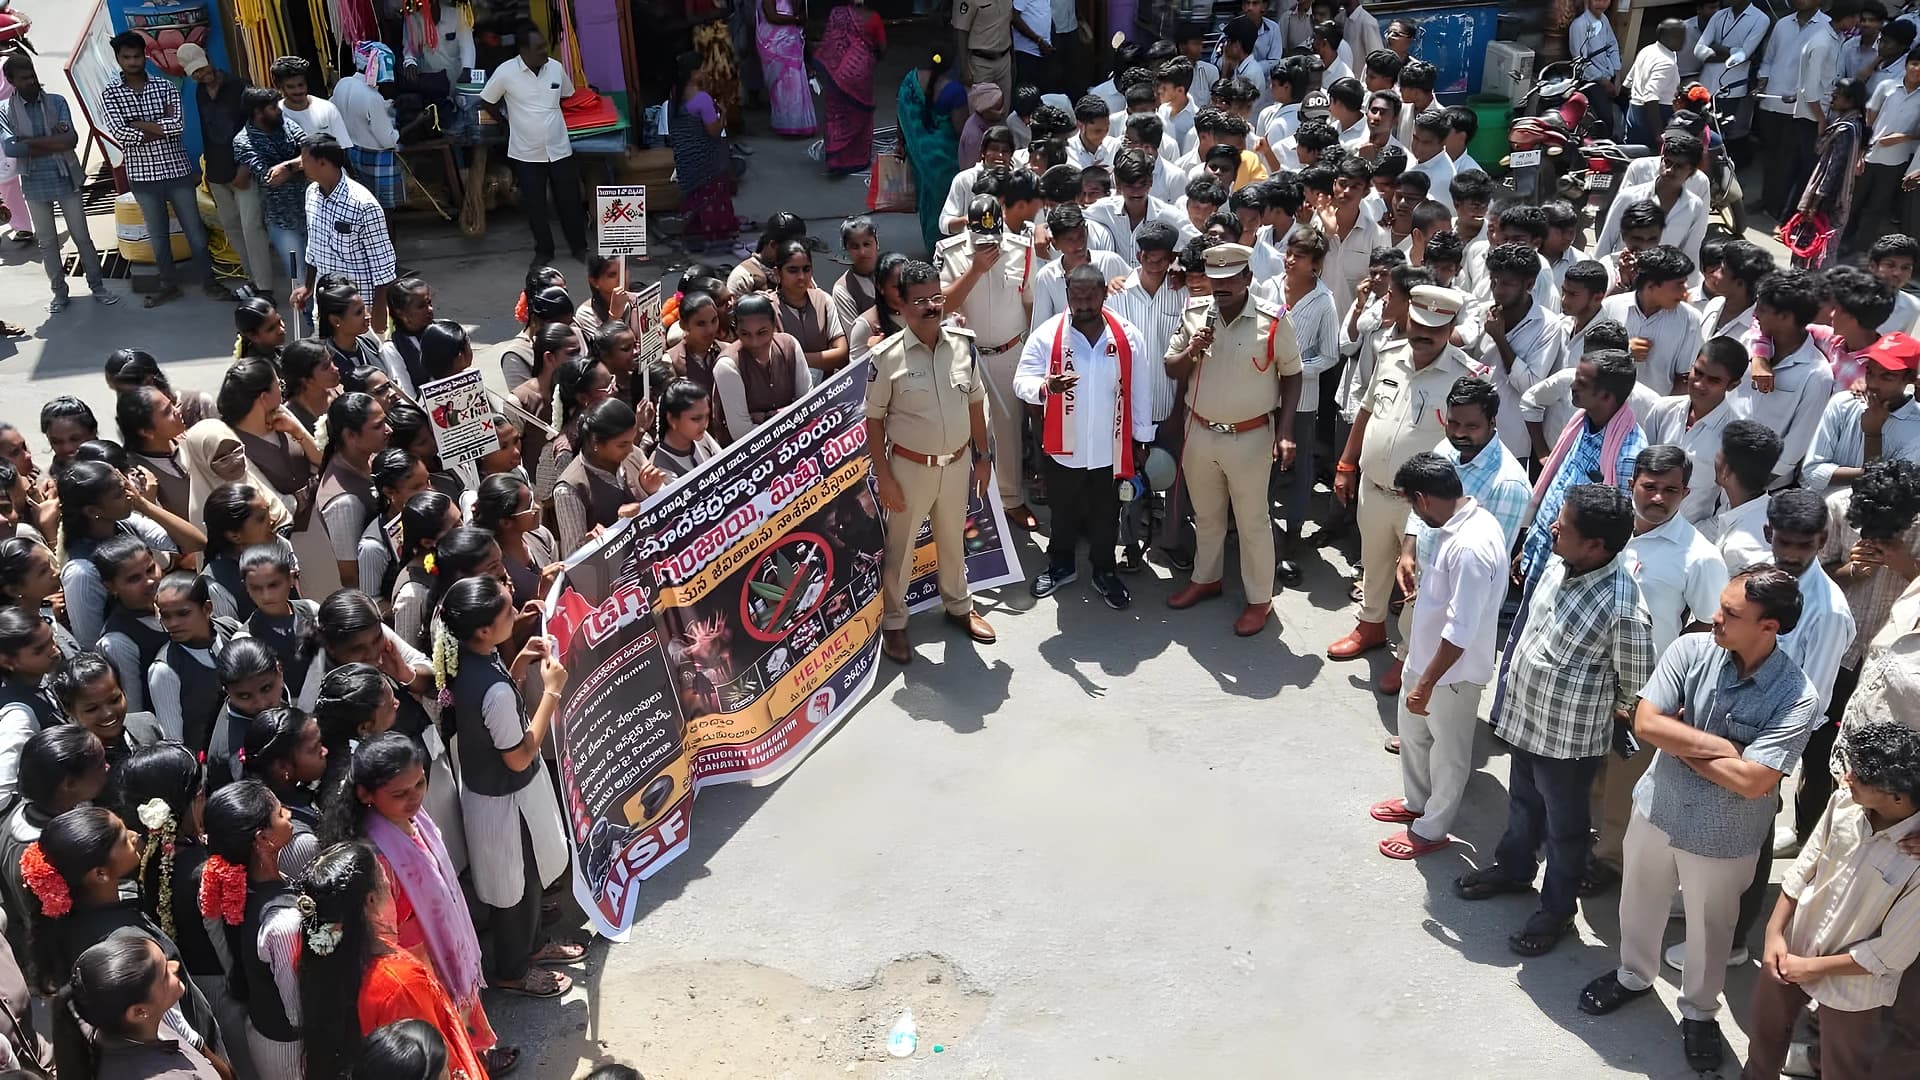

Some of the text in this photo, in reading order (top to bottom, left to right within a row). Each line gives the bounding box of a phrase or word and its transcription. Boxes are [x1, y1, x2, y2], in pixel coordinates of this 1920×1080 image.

[639, 411, 842, 560] మాదకద్రవ్యాలు మరియు
[768, 457, 823, 505] మత్తు
[683, 464, 859, 600] మన జీవితాలను నాశనం చేస్తాయి
[614, 660, 651, 686] Women
[793, 630, 850, 686] HELMET
[698, 749, 748, 763] STUDENT
[604, 809, 686, 918] AISF
